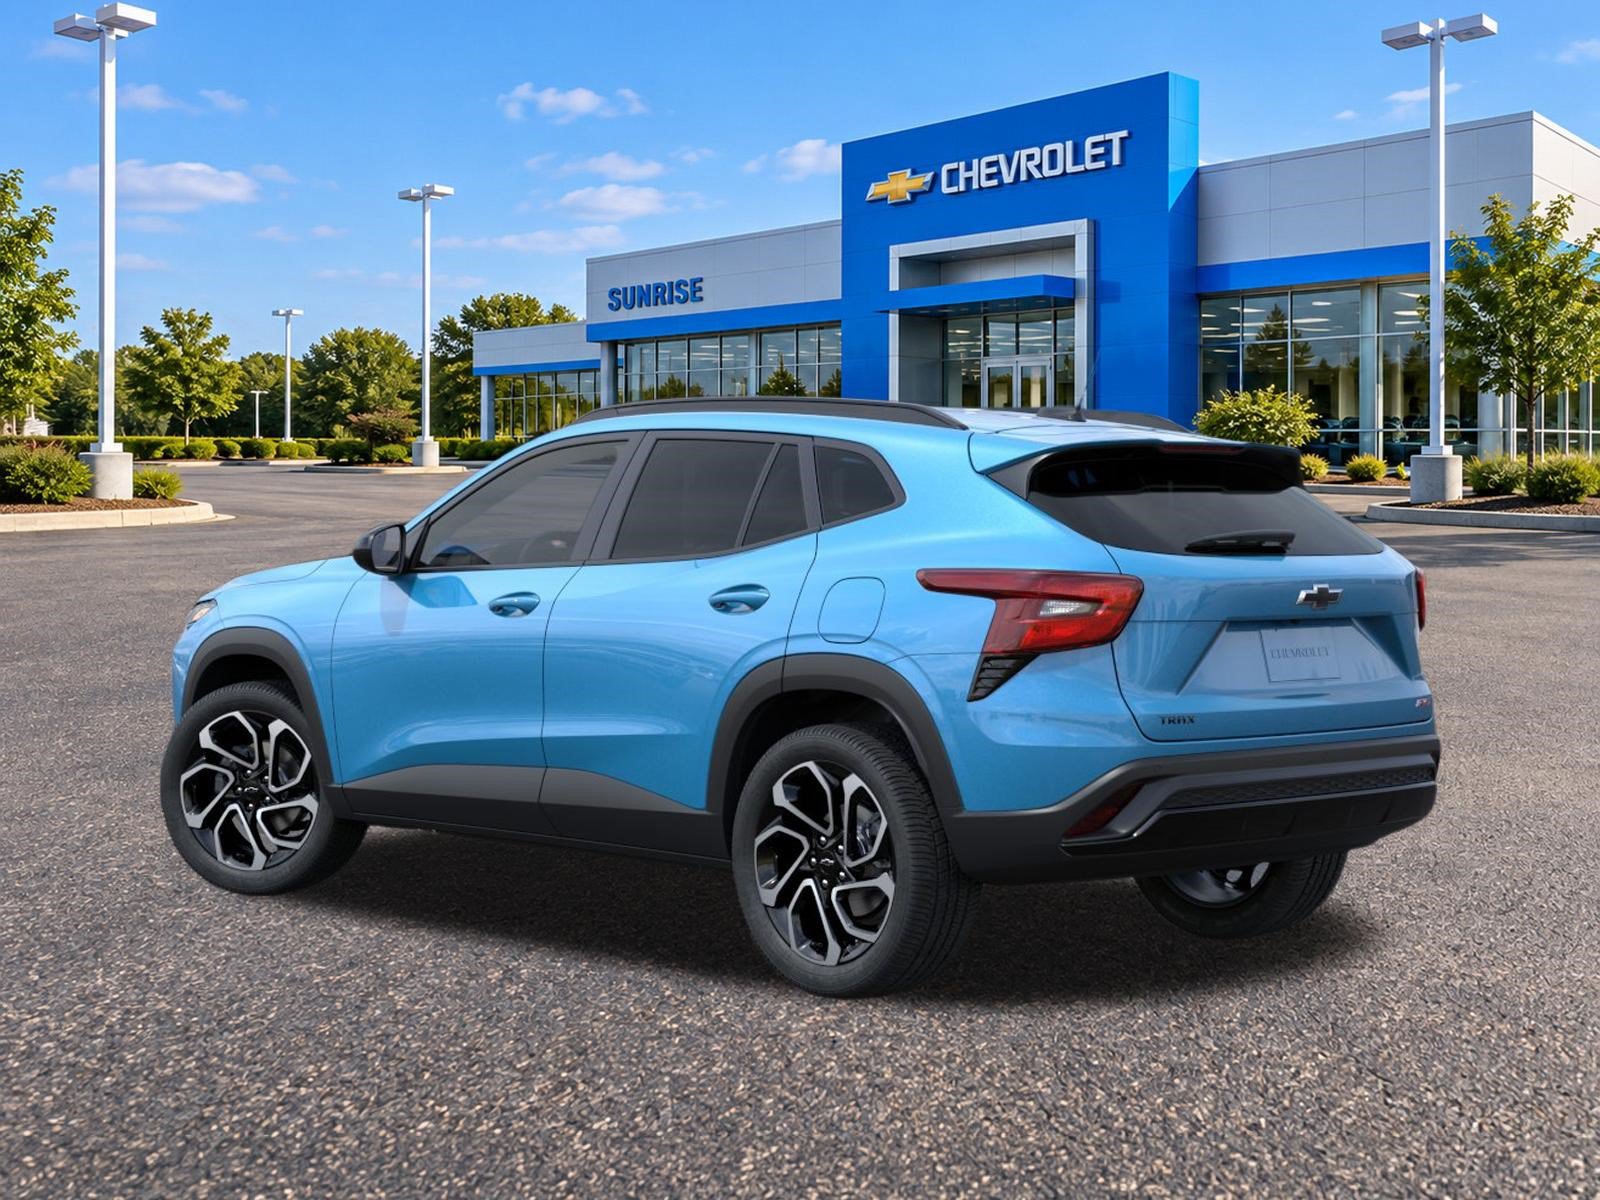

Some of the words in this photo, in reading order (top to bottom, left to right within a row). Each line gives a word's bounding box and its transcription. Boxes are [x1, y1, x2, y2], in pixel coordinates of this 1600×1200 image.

[941, 130, 1129, 194] CHEVROLET
[608, 277, 704, 312] SUNRISE
[1270, 647, 1329, 659] CHEVROLET
[1159, 714, 1196, 725] TRAX
